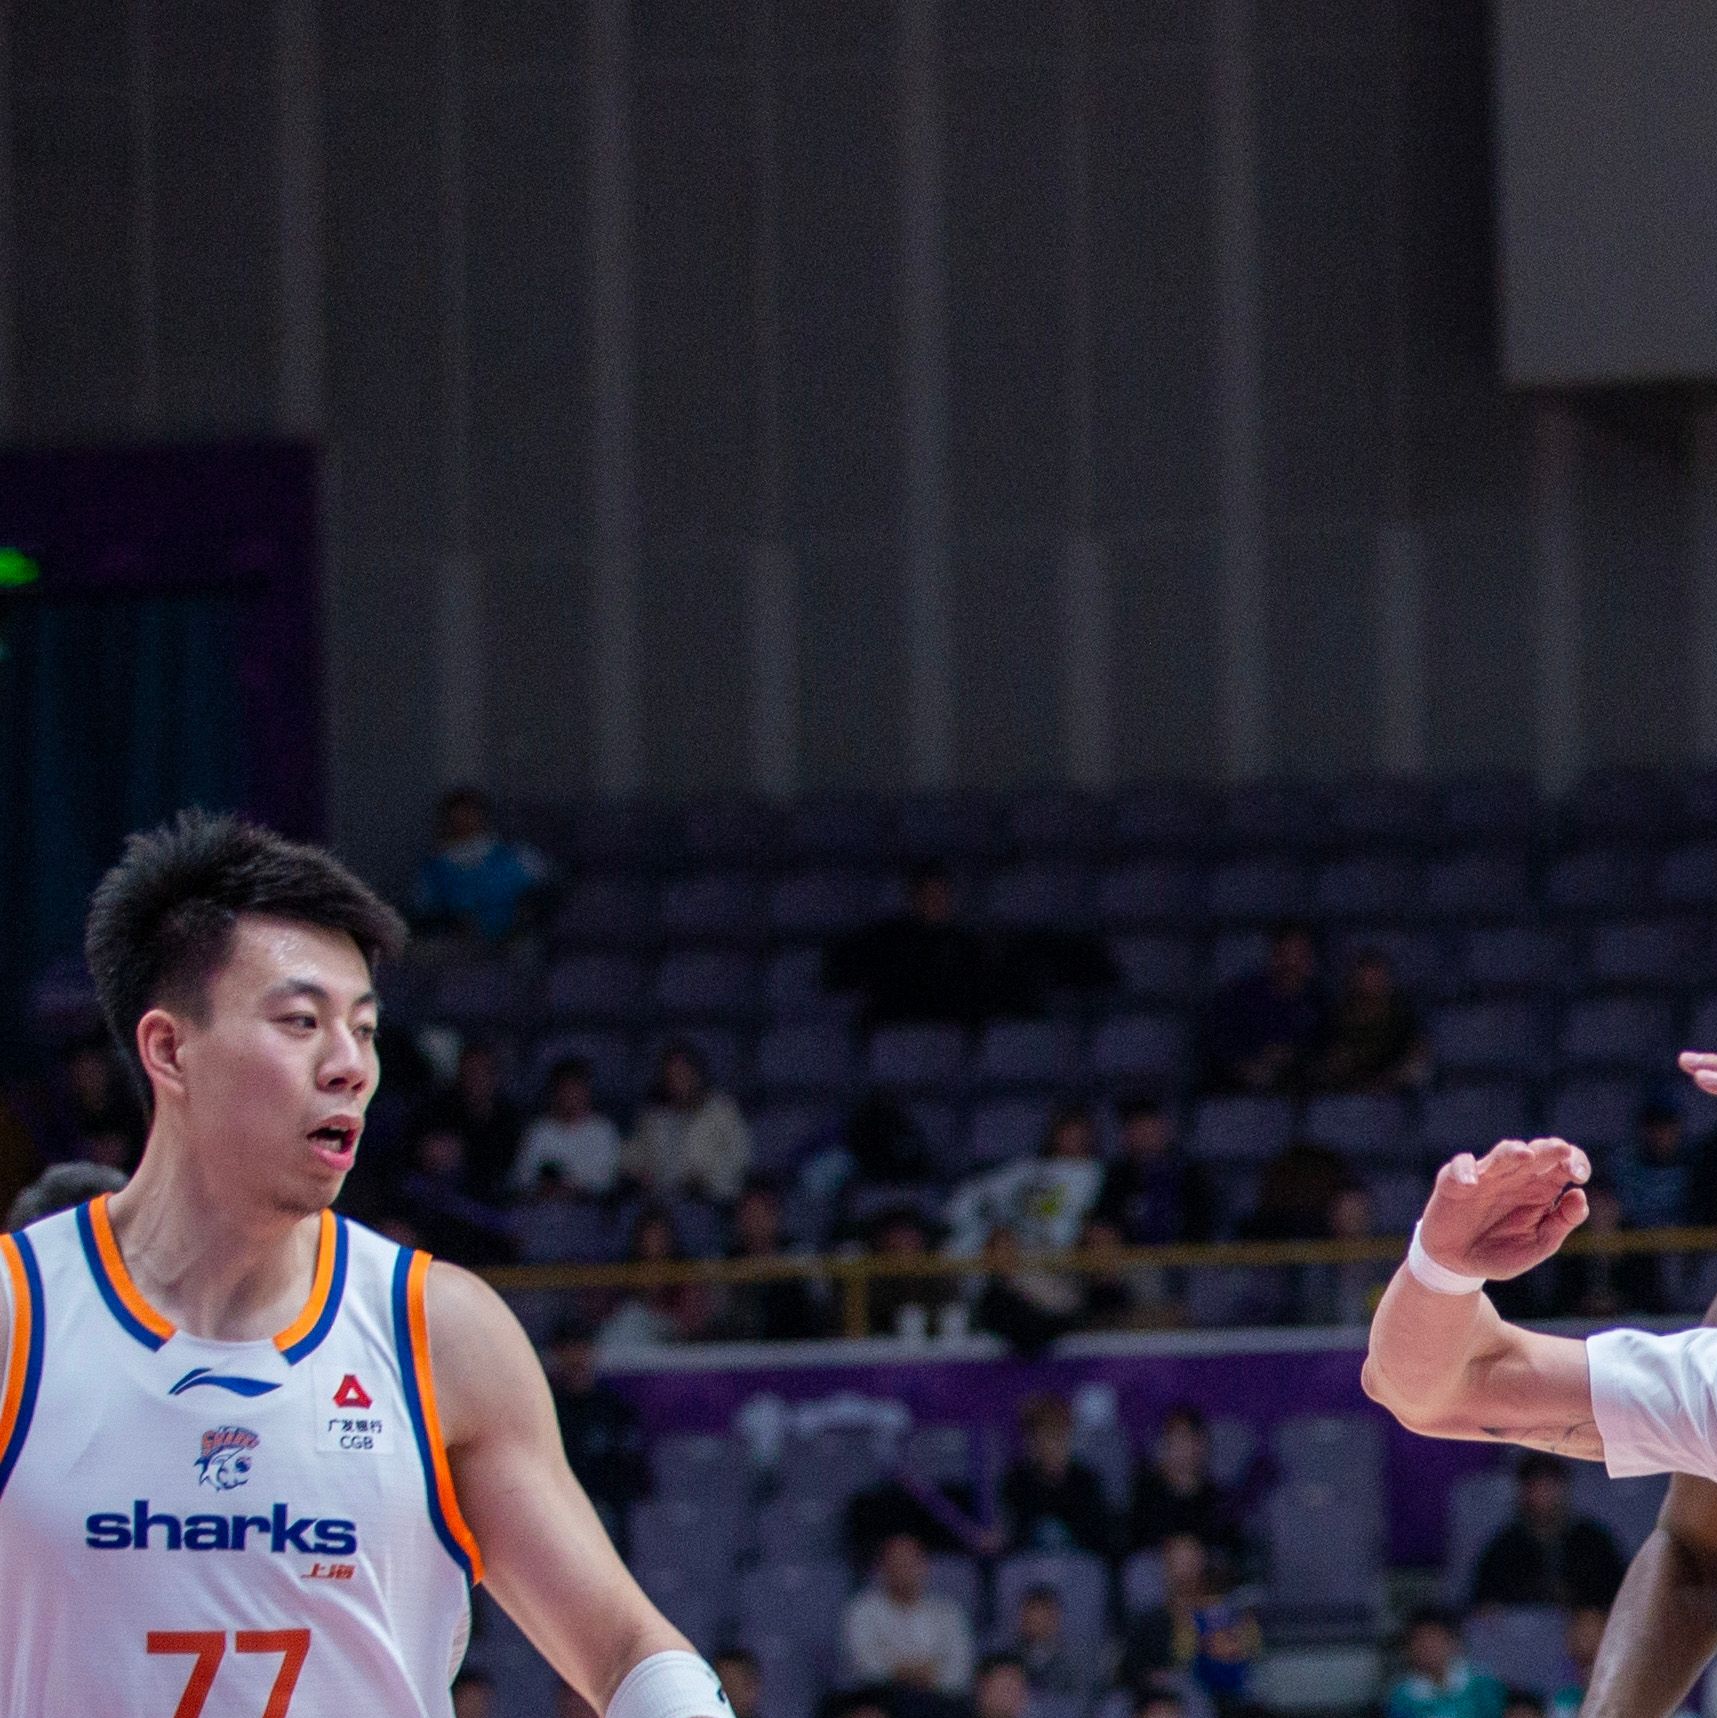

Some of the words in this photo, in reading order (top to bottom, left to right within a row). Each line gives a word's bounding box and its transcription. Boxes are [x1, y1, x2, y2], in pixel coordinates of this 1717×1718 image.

[328, 1418, 383, 1434] 广发银行
[340, 1436, 374, 1450] CGB
[86, 1500, 358, 1555] sharks
